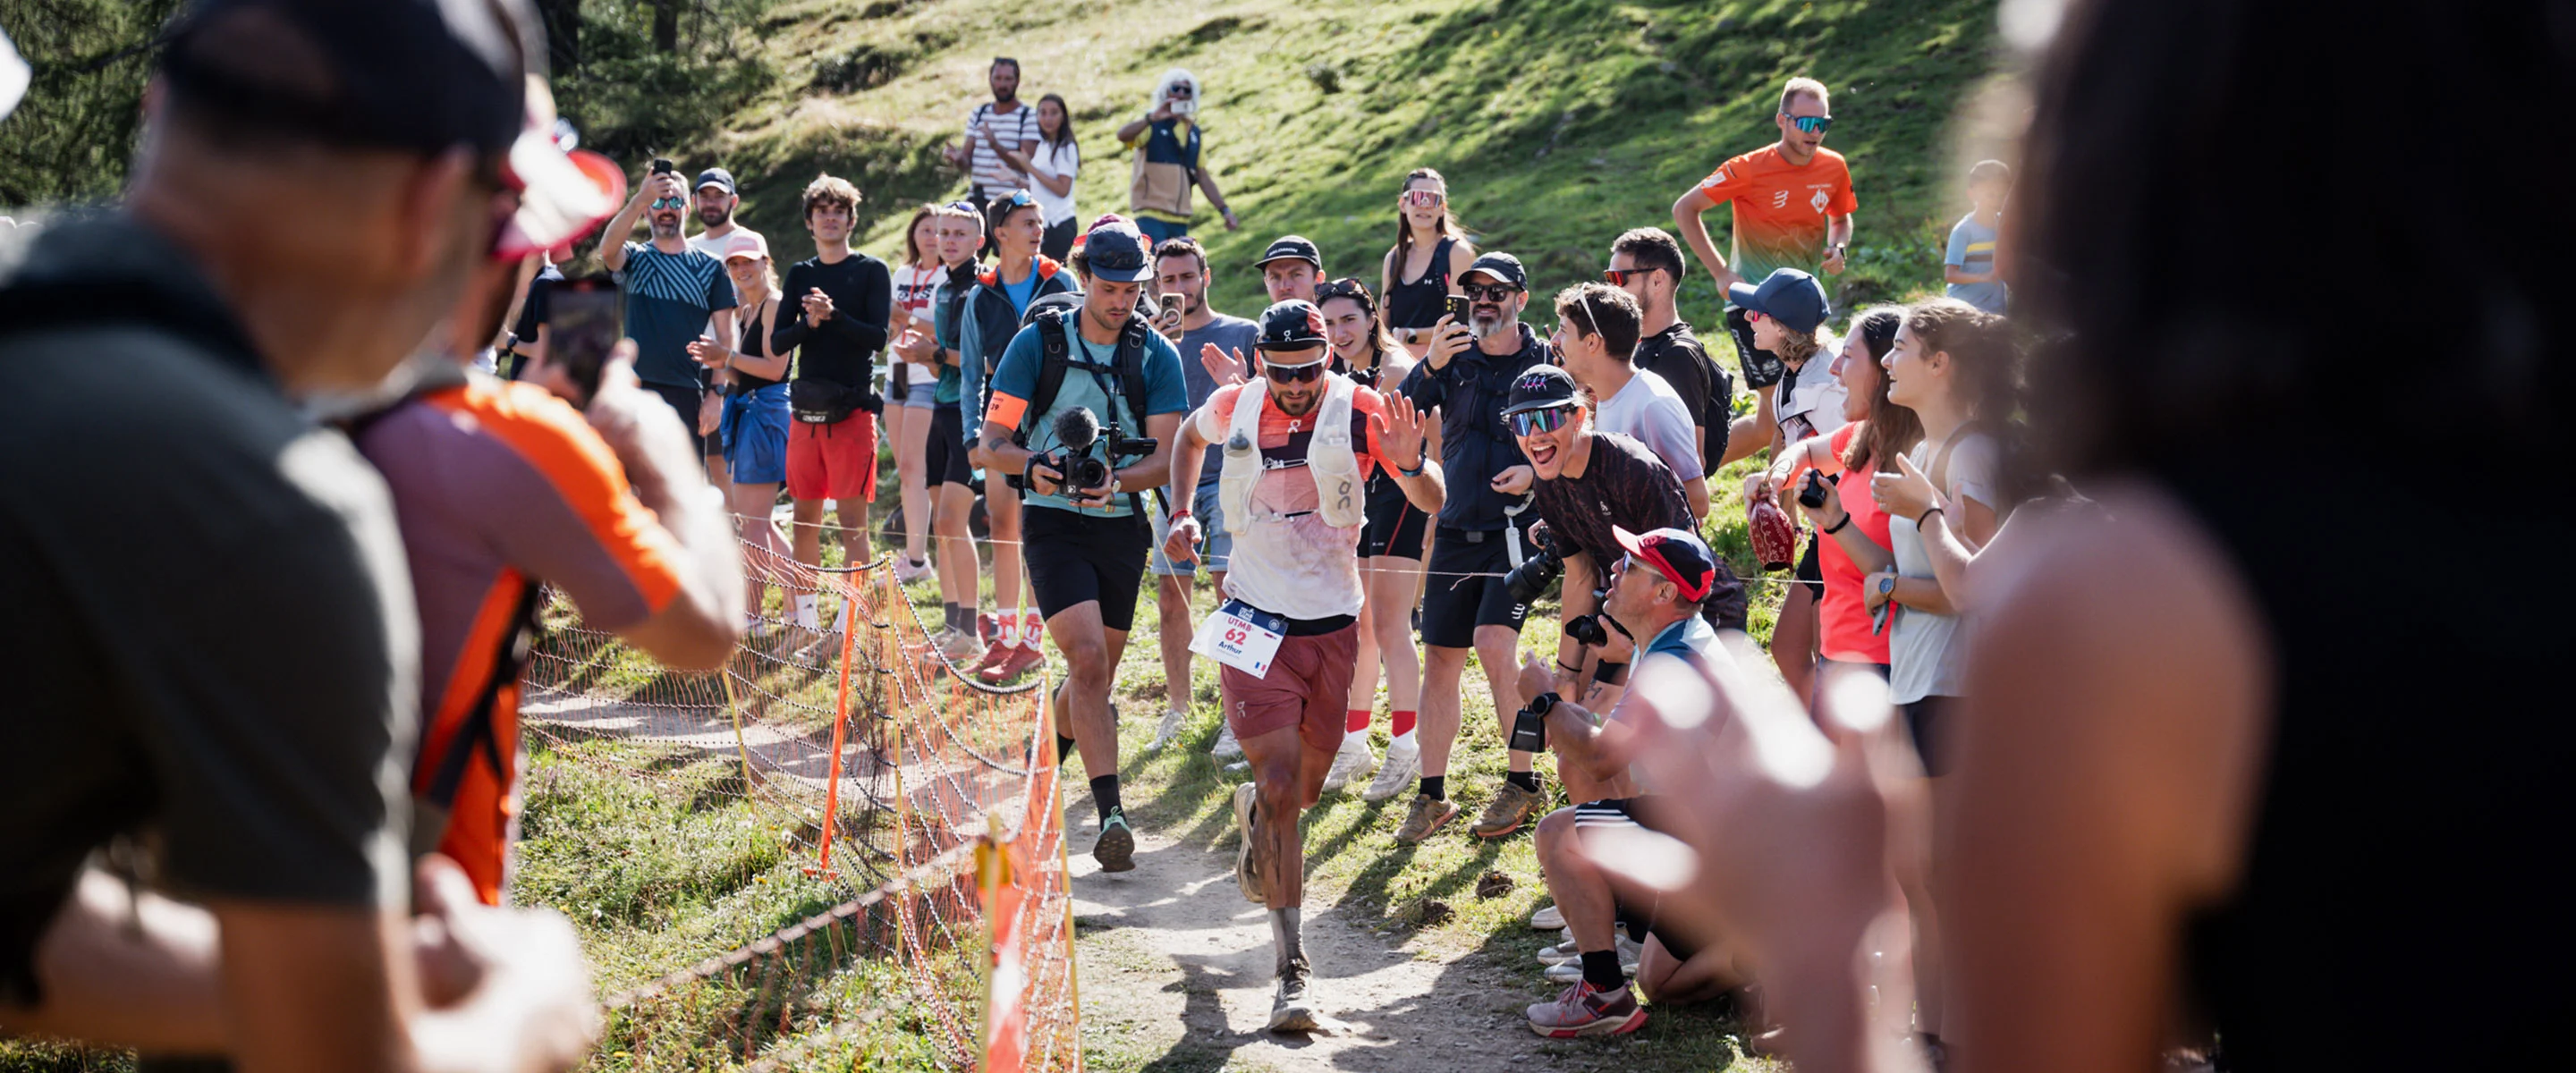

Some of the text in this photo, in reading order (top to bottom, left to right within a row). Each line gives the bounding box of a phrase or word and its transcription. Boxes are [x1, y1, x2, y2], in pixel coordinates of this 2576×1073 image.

[1227, 616, 1252, 632] UTMB
[1224, 628, 1247, 646] 62
[1218, 640, 1242, 655] Arthur
